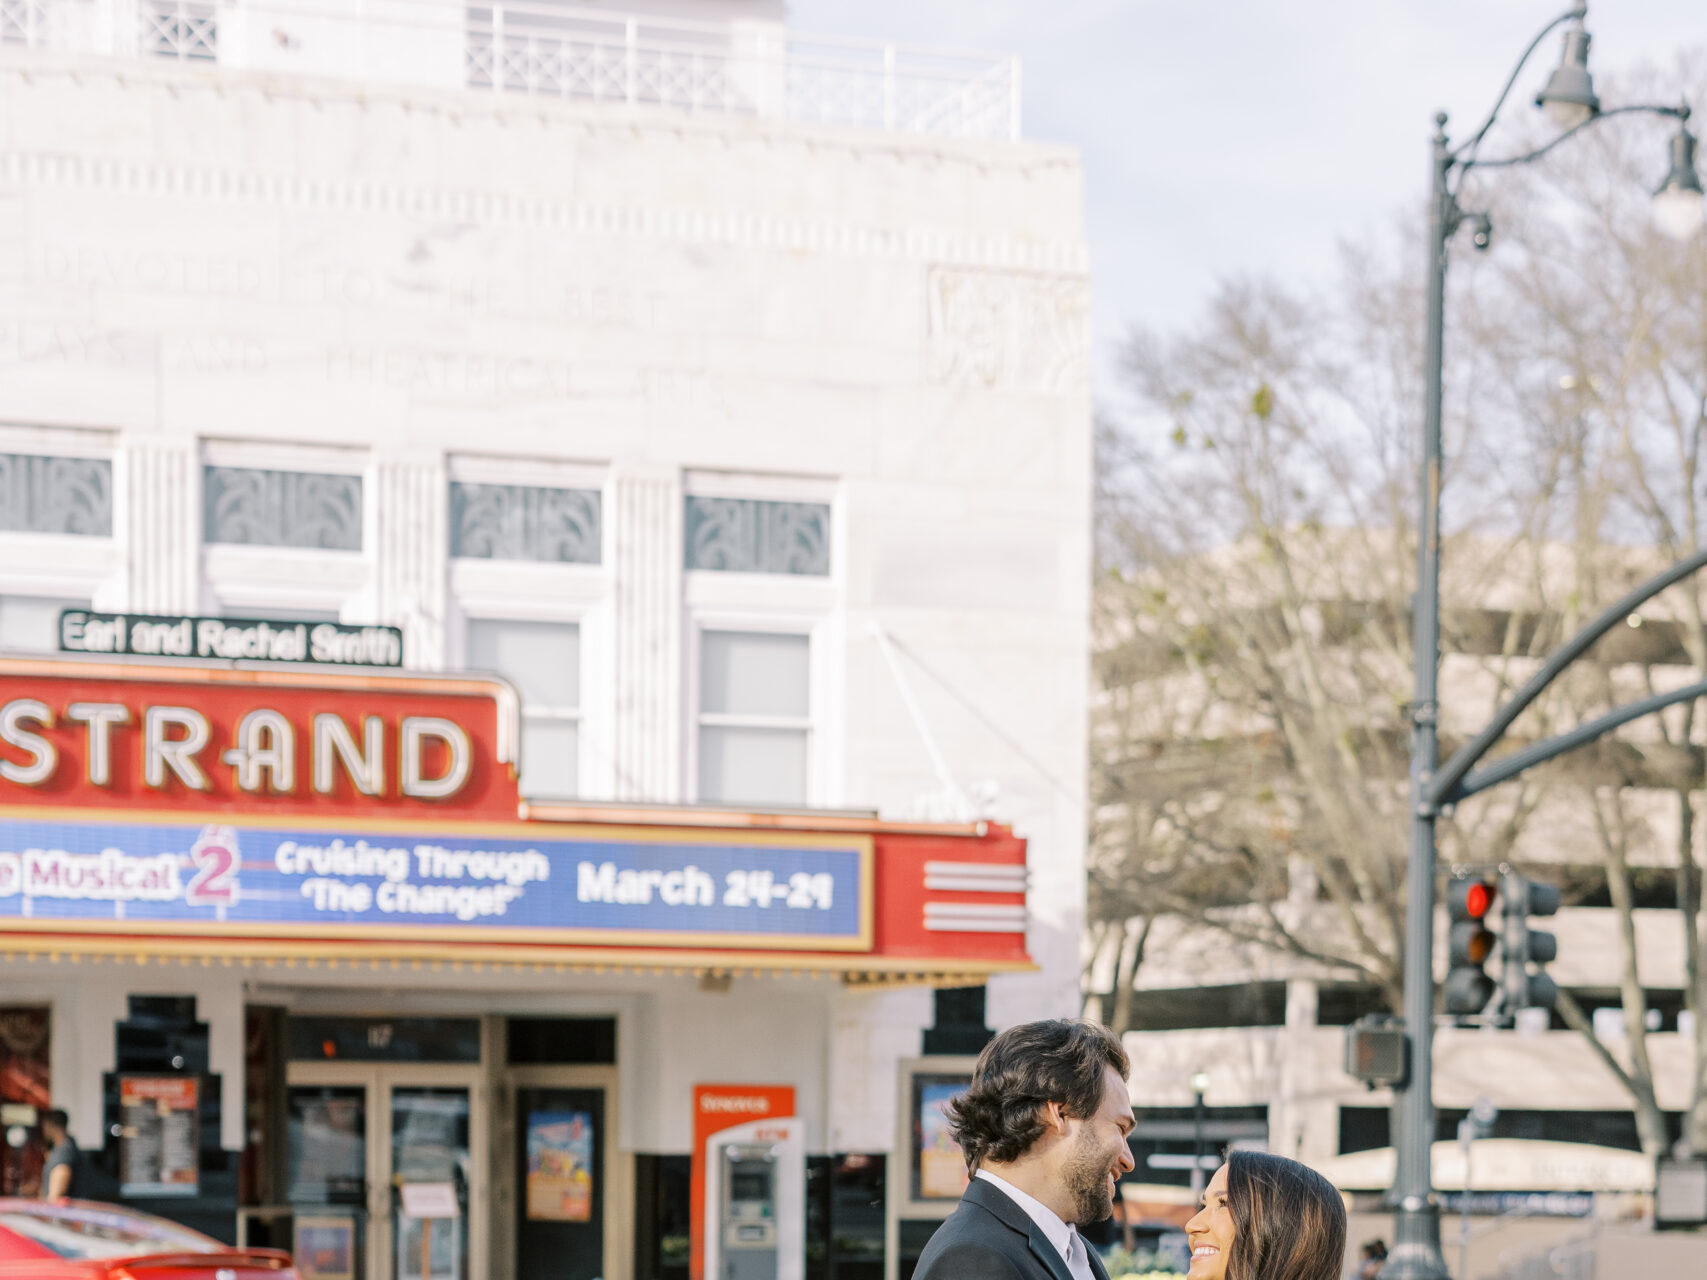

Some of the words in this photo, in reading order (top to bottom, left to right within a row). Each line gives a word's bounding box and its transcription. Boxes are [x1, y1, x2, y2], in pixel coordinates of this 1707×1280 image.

[43, 244, 263, 296] DEVOTED
[319, 265, 374, 305] TO
[175, 333, 270, 373] AND
[63, 612, 127, 652] Earl
[130, 618, 192, 656] and
[197, 620, 306, 661] Rachel
[310, 624, 401, 665] Smith
[0, 698, 473, 798] STRAND
[28, 853, 175, 892] Musical
[275, 839, 410, 883] Cruising
[413, 844, 550, 886] Through
[577, 861, 715, 905] March
[723, 869, 834, 910] 24-29
